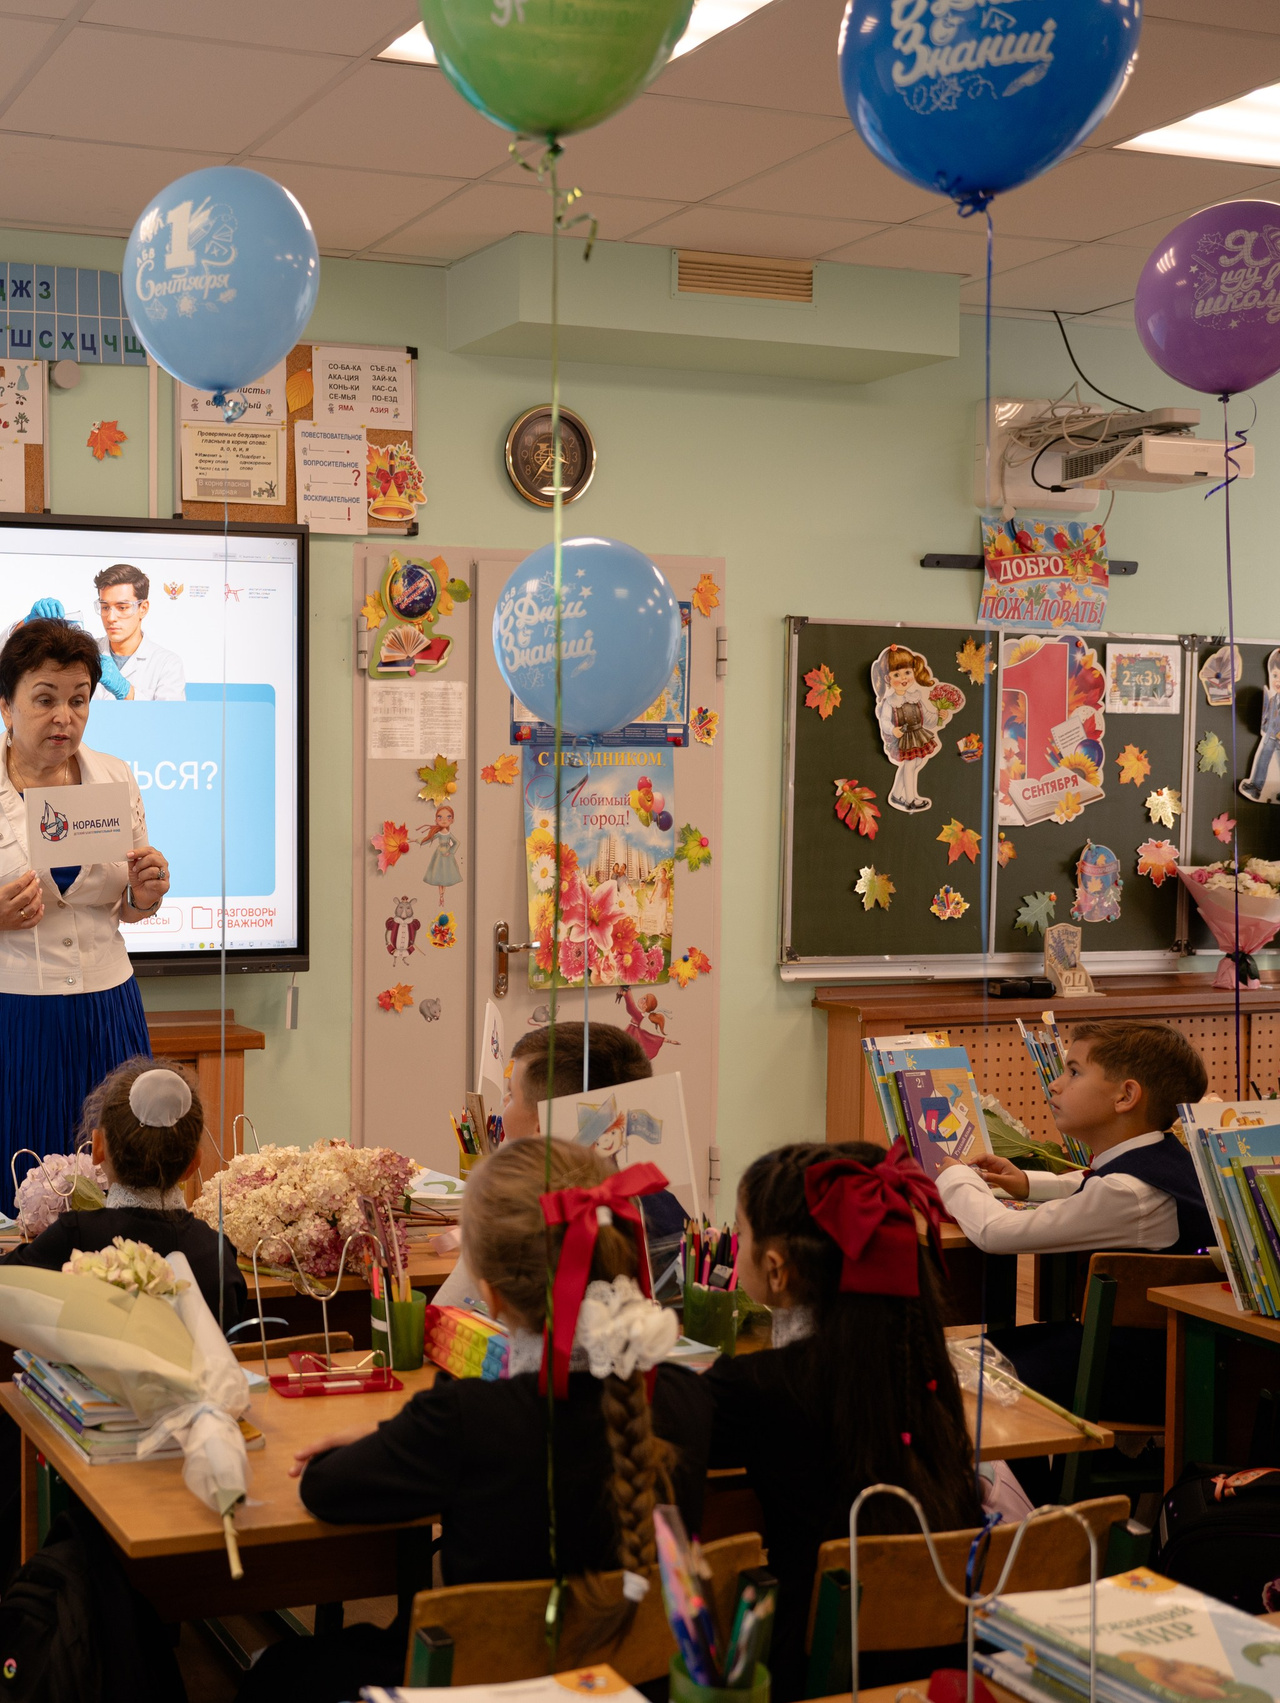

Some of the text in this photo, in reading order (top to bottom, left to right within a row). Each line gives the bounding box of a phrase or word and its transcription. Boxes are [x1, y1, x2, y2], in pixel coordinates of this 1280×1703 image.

[891, 17, 1058, 87] Знаний
[165, 201, 196, 269] 1
[1219, 229, 1269, 267] Я
[136, 250, 237, 300] Сентября
[11, 280, 31, 298] ж
[38, 281, 51, 299] з
[11, 329, 31, 347] ш
[39, 330, 52, 348] с
[61, 332, 74, 350] х
[82, 334, 96, 354] ц
[104, 335, 117, 352] ч
[328, 364, 396, 373] СО-БА-КА СЪЕ-ЛА
[328, 374, 397, 382] АКА-ЦИЯ ЗАЙ-КА
[328, 384, 397, 393] КОНЬ-КИ КАС-СА
[329, 393, 398, 403] СЕ-МЬЯ ПО-ЕЗД
[338, 404, 389, 414] ЯМА АЗИЯ
[301, 431, 362, 441] ПОВЕСТВОВАТЕЛЬНОЕ
[303, 459, 359, 468] ВОПРОСИТЕЛЬНОЕ
[304, 494, 360, 504] ВОСКЛИЦАТЕЛЬНОЕ
[999, 556, 1064, 583] ДОБРО
[981, 596, 1106, 624] ПОЖАЛОВАТЬ!
[1122, 670, 1131, 686] 2
[538, 751, 550, 766] С
[1021, 774, 1080, 800] СЕНТЯБРЯ
[72, 818, 120, 830] КОРАБЛИК
[583, 810, 630, 830] город!
[217, 908, 276, 917] РАЗГОВОРЫ
[227, 918, 274, 928] ВАЖНОМ
